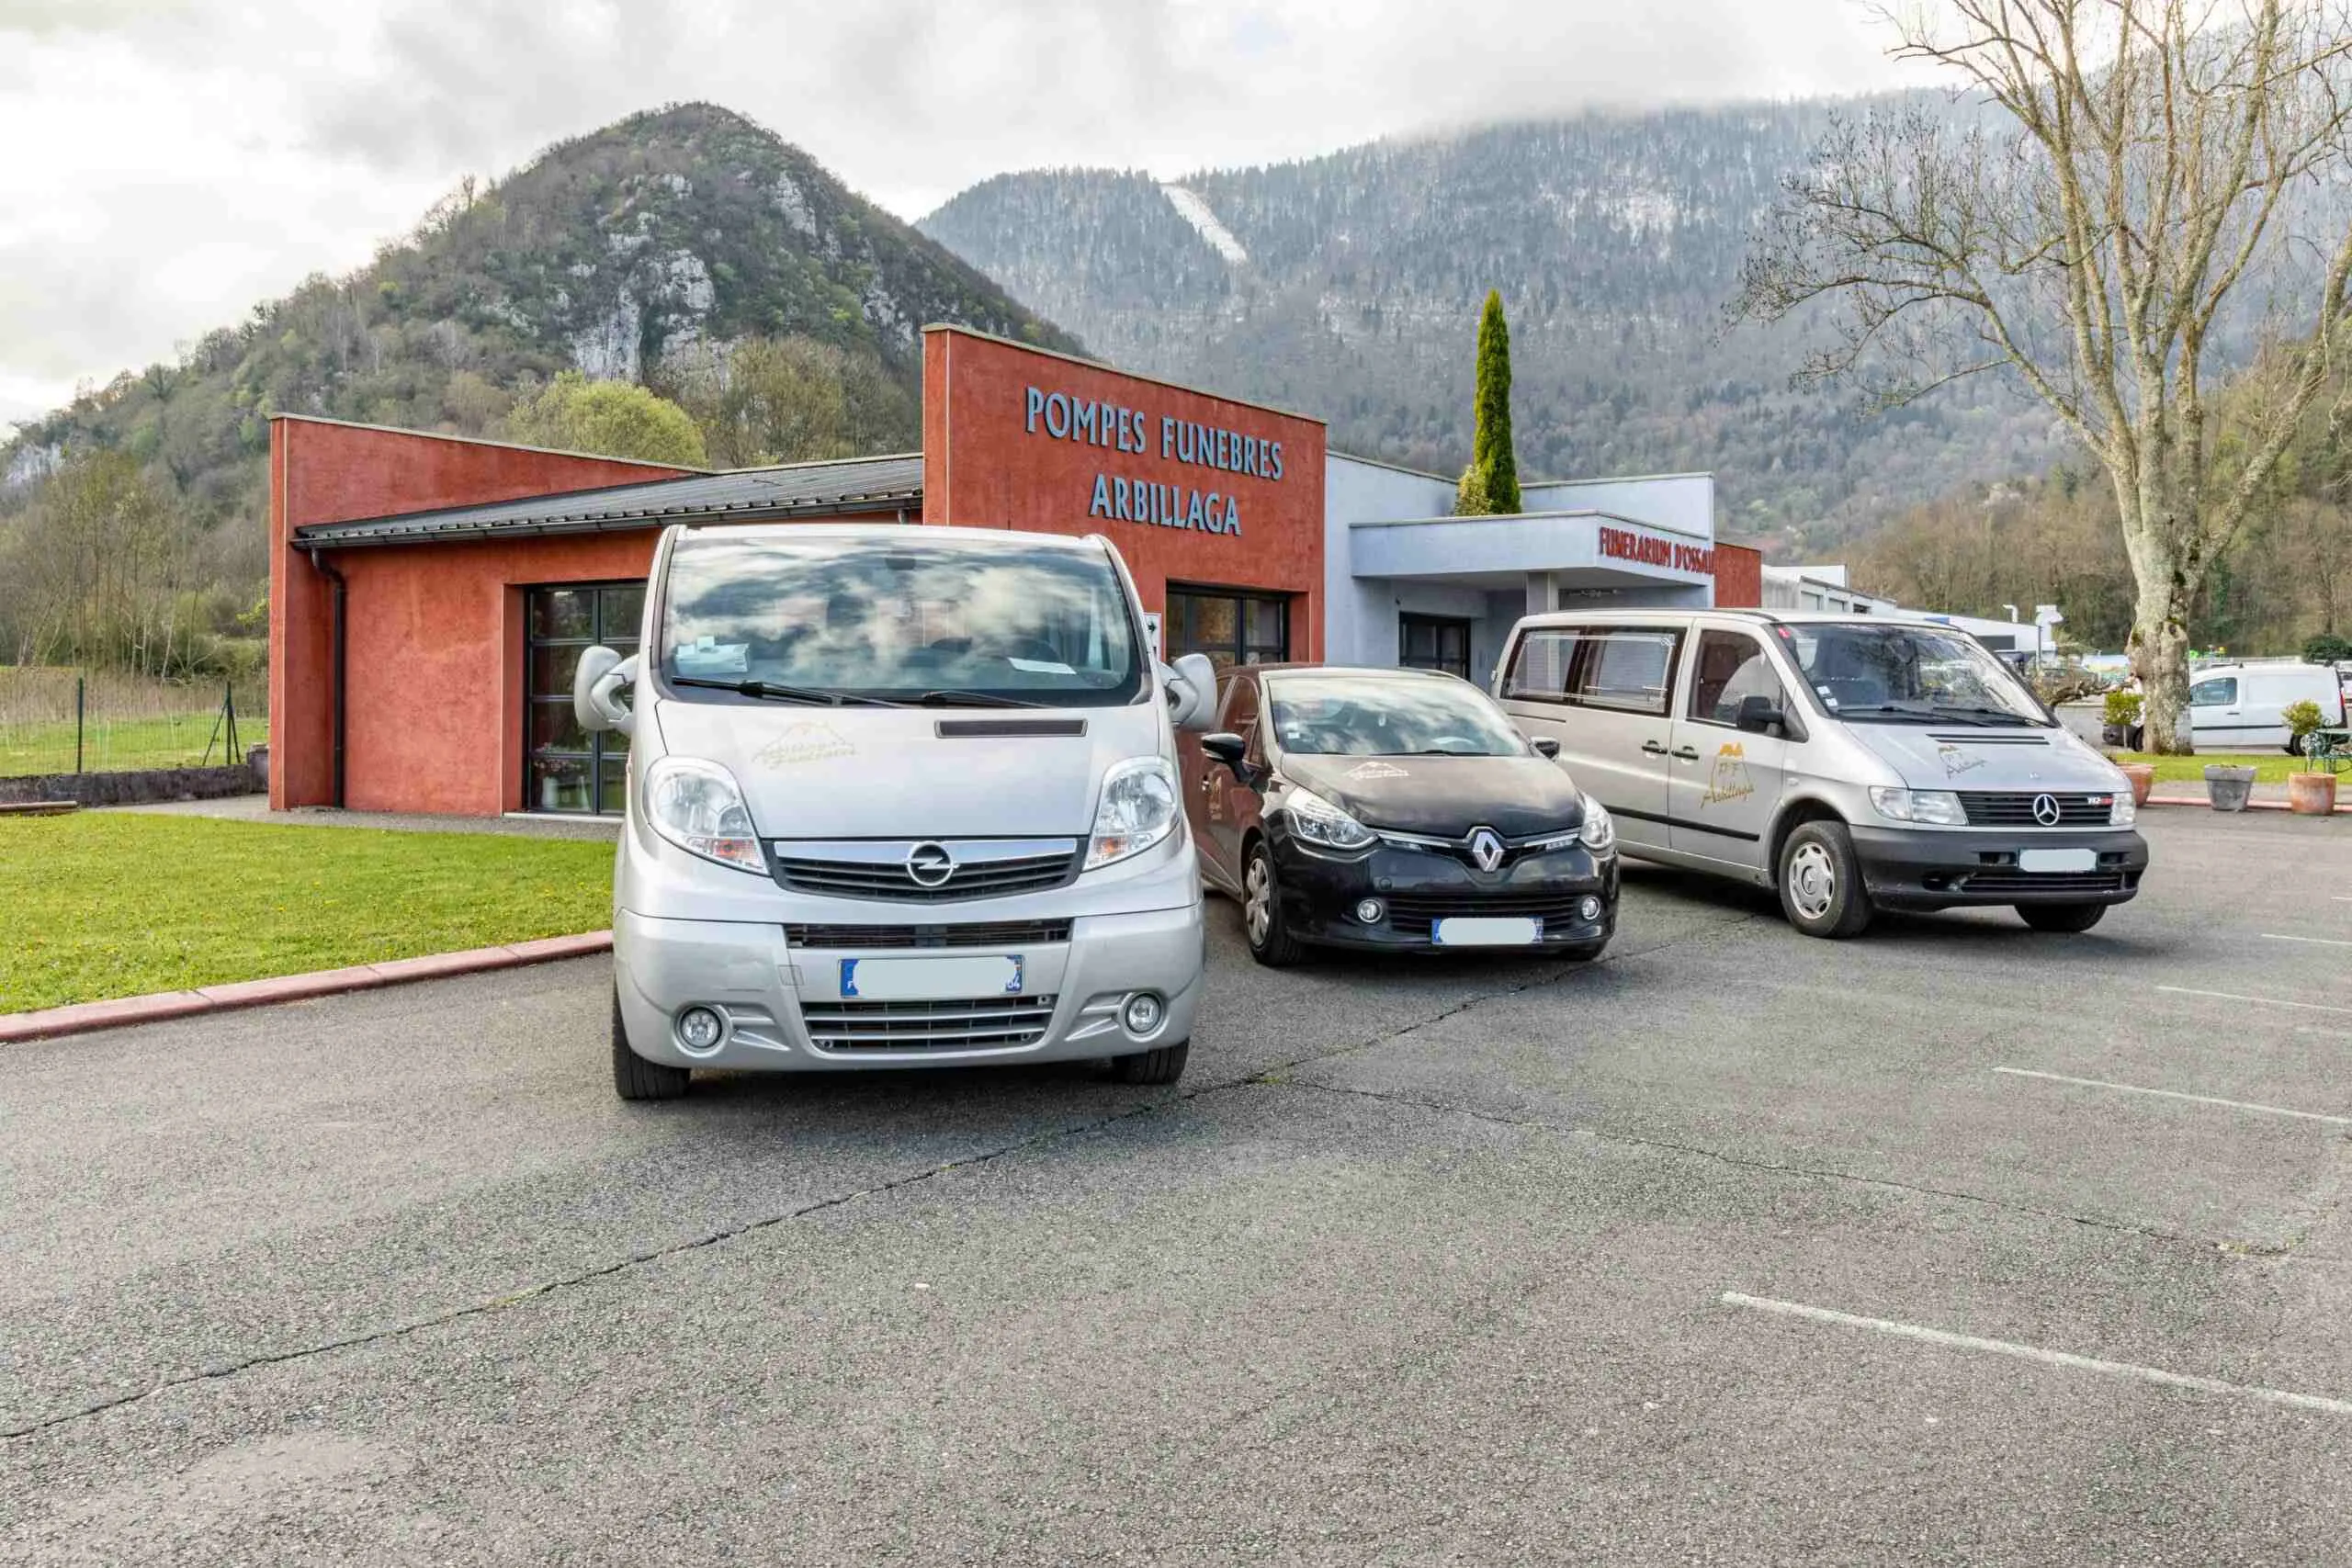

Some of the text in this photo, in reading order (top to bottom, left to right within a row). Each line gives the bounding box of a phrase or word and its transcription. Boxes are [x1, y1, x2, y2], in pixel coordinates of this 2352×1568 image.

[1026, 386, 1283, 480] POMPES FUNEBRES
[1089, 473, 1242, 536] ARBILLAGA
[1600, 526, 1672, 568] FUNERARIUM
